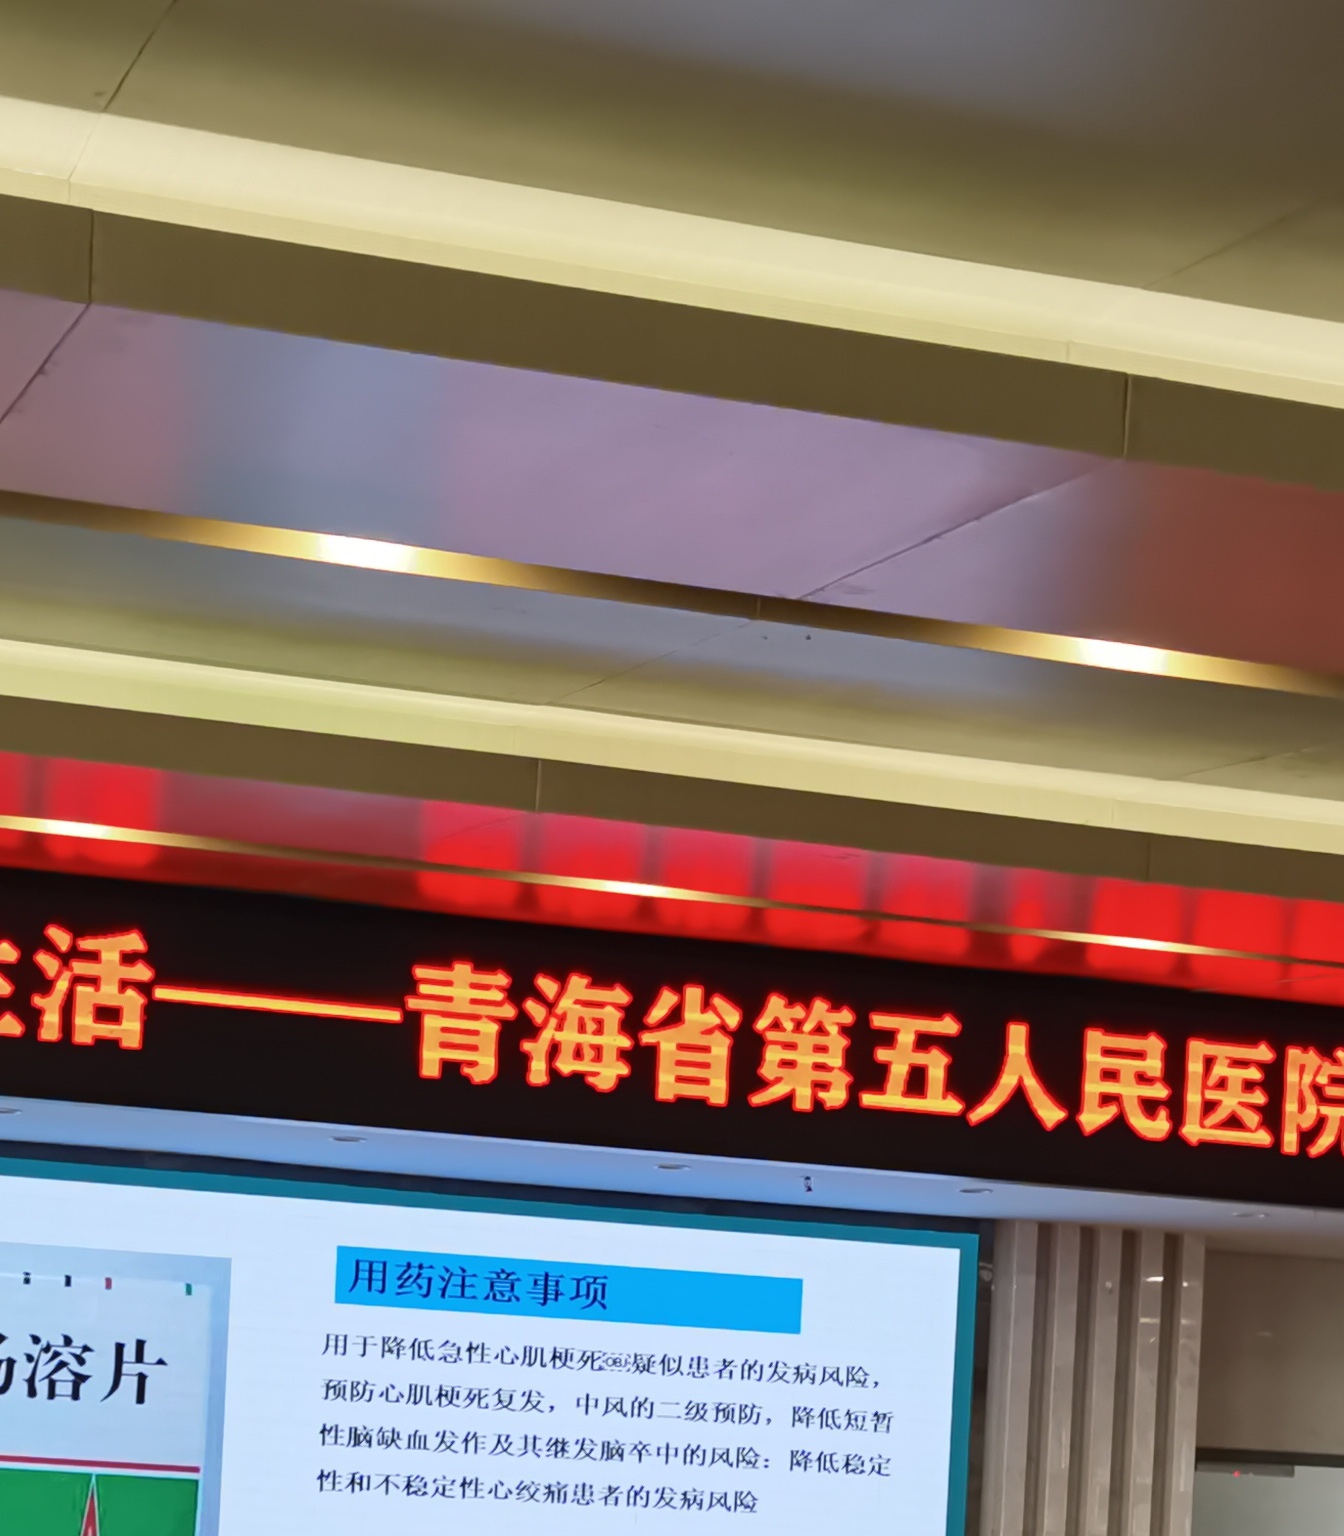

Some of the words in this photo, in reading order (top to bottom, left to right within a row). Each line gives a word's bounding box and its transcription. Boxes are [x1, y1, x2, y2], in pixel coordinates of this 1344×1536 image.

[348, 1258, 609, 1310] 用药注意事项
